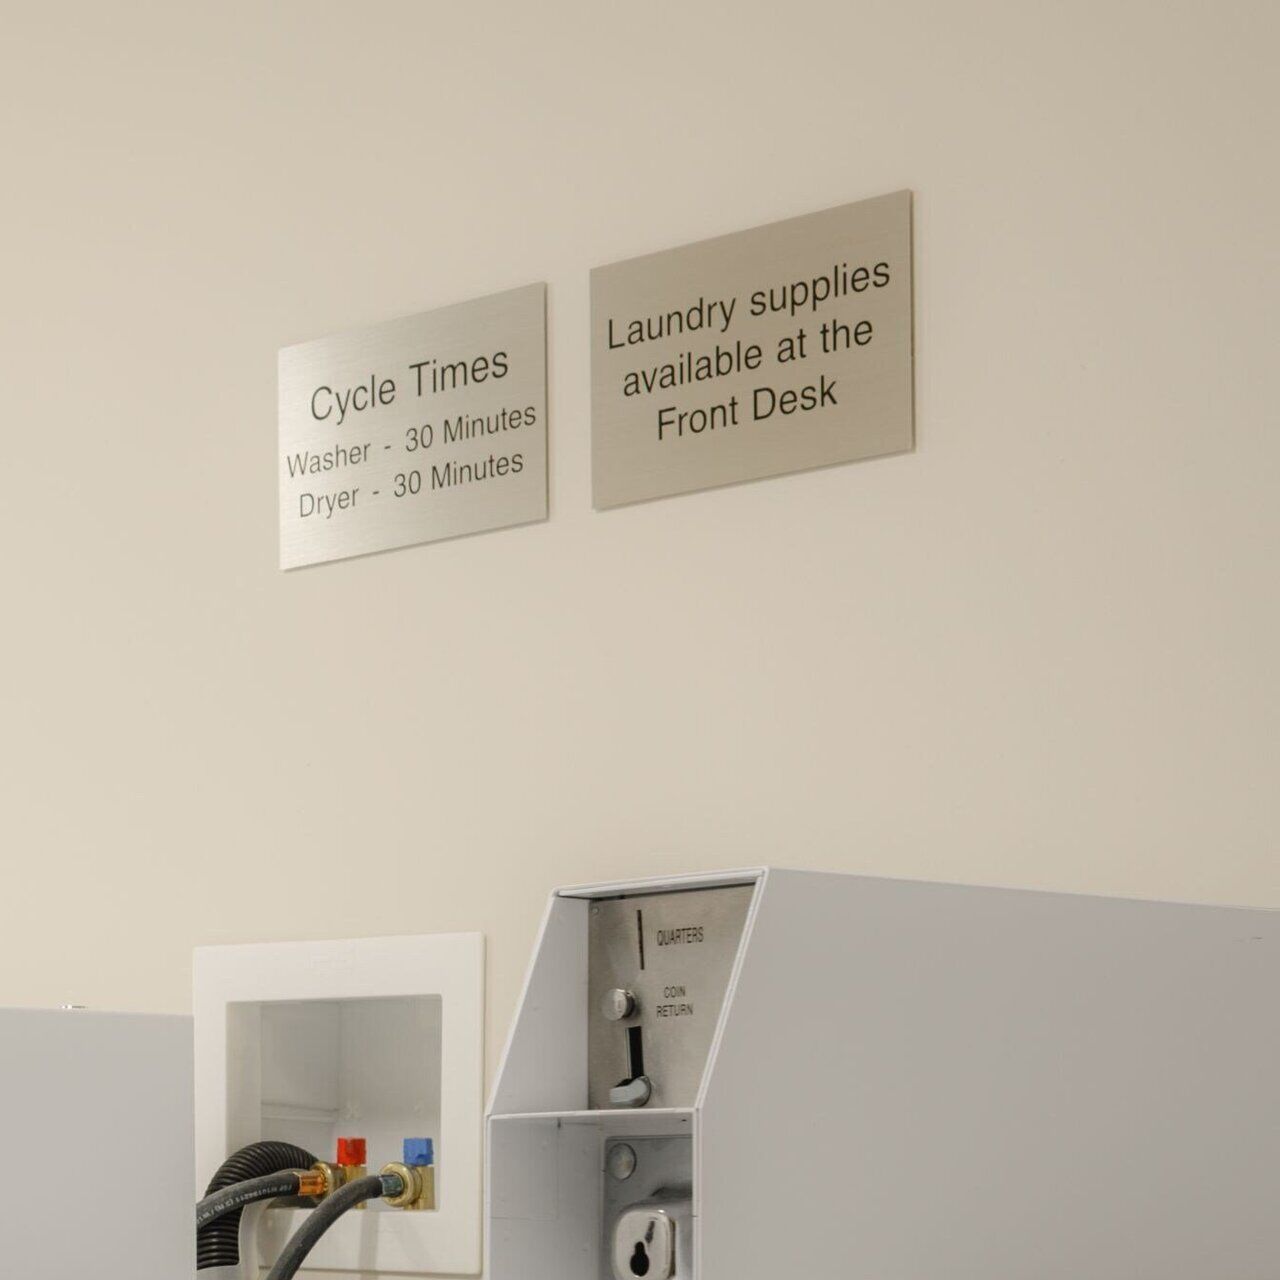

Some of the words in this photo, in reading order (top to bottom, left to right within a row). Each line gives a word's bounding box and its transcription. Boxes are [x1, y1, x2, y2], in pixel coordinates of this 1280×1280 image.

[607, 296, 737, 350] Laundry
[749, 261, 891, 318] supplies
[310, 374, 397, 426] Cycle
[408, 351, 509, 398] Times
[623, 340, 763, 398] available
[776, 327, 808, 364] at
[819, 318, 874, 354] the
[657, 395, 739, 441] Front
[752, 374, 838, 422] Desk
[286, 443, 372, 479] Washer
[405, 424, 434, 453] 30
[443, 405, 538, 445] Minutes
[299, 487, 360, 520] Dryer
[393, 469, 422, 498] 30
[431, 453, 524, 491] Minutes
[656, 926, 704, 946] QUARTERS
[656, 1003, 694, 1017] RETURN
[663, 985, 686, 998] COIN
